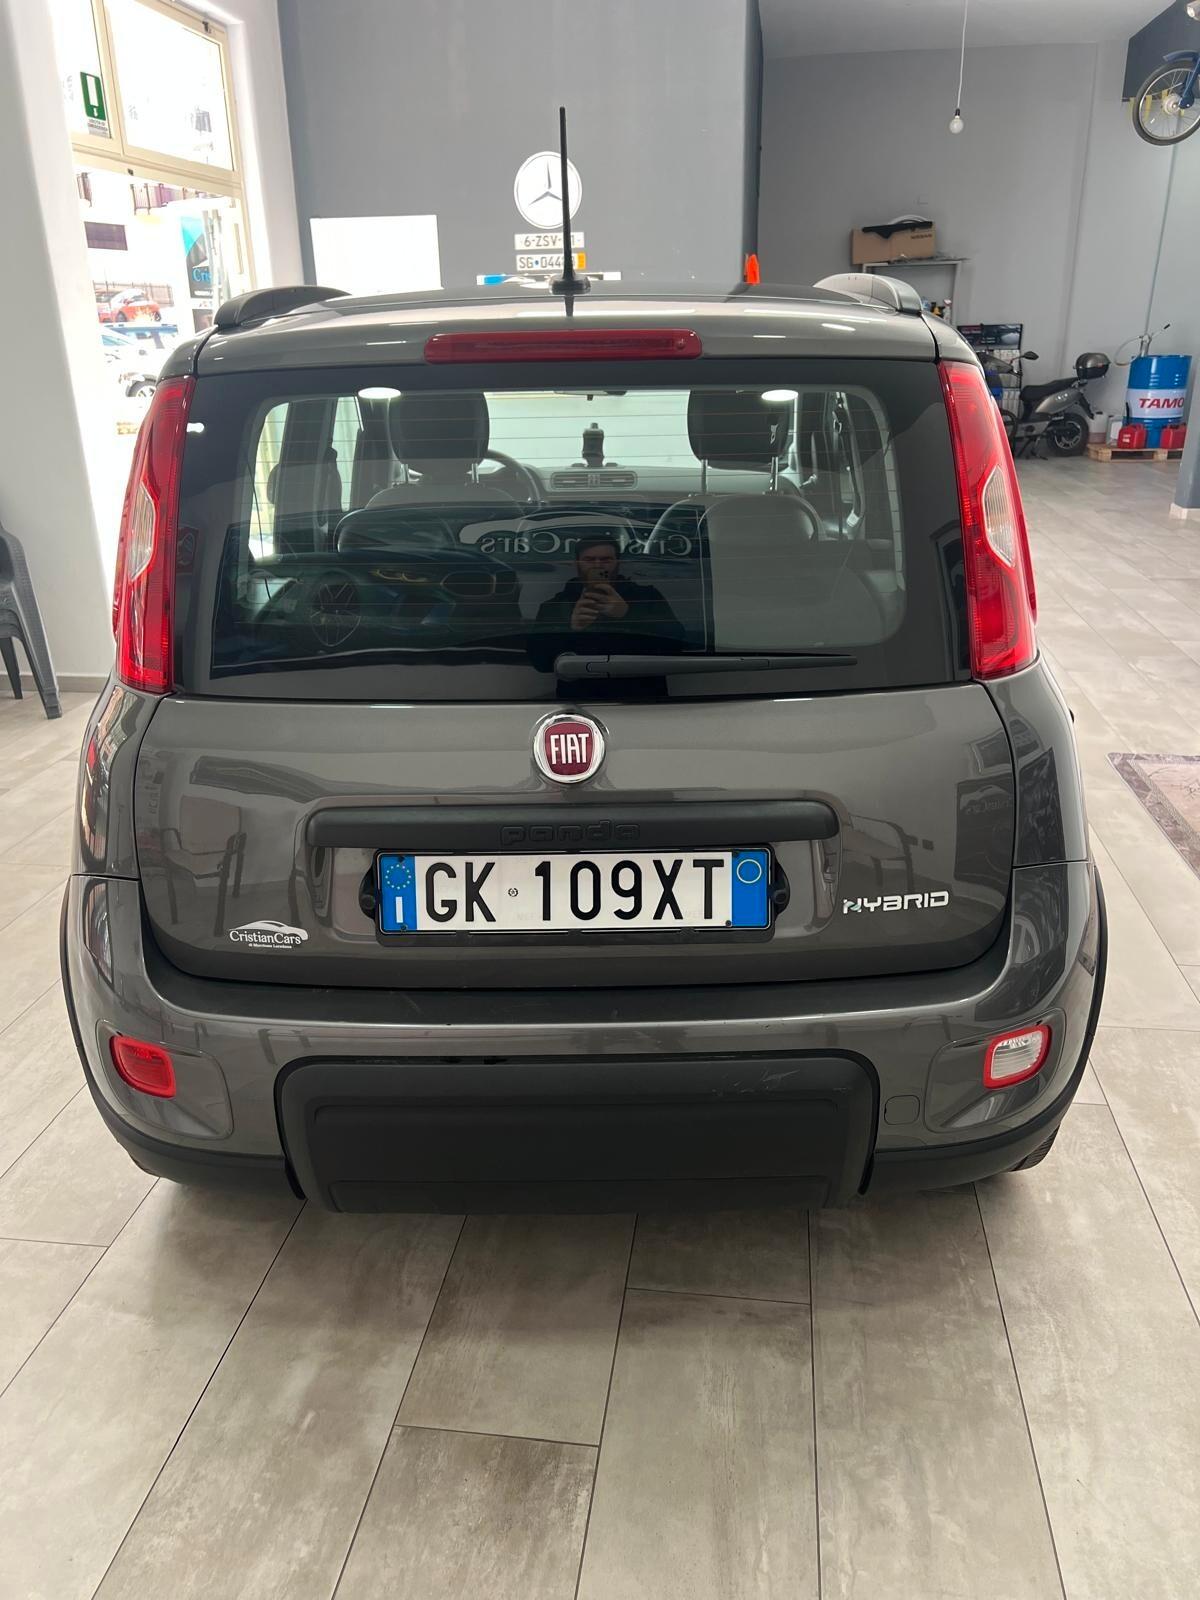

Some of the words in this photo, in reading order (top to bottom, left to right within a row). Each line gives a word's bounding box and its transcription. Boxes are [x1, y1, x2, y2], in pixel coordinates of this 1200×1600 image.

[550, 733, 589, 765] FIAT
[500, 819, 641, 846] panda
[425, 861, 497, 923] GK
[534, 858, 725, 922] 109XT
[842, 890, 950, 914] HYBRID
[229, 931, 302, 944] CristianCars
